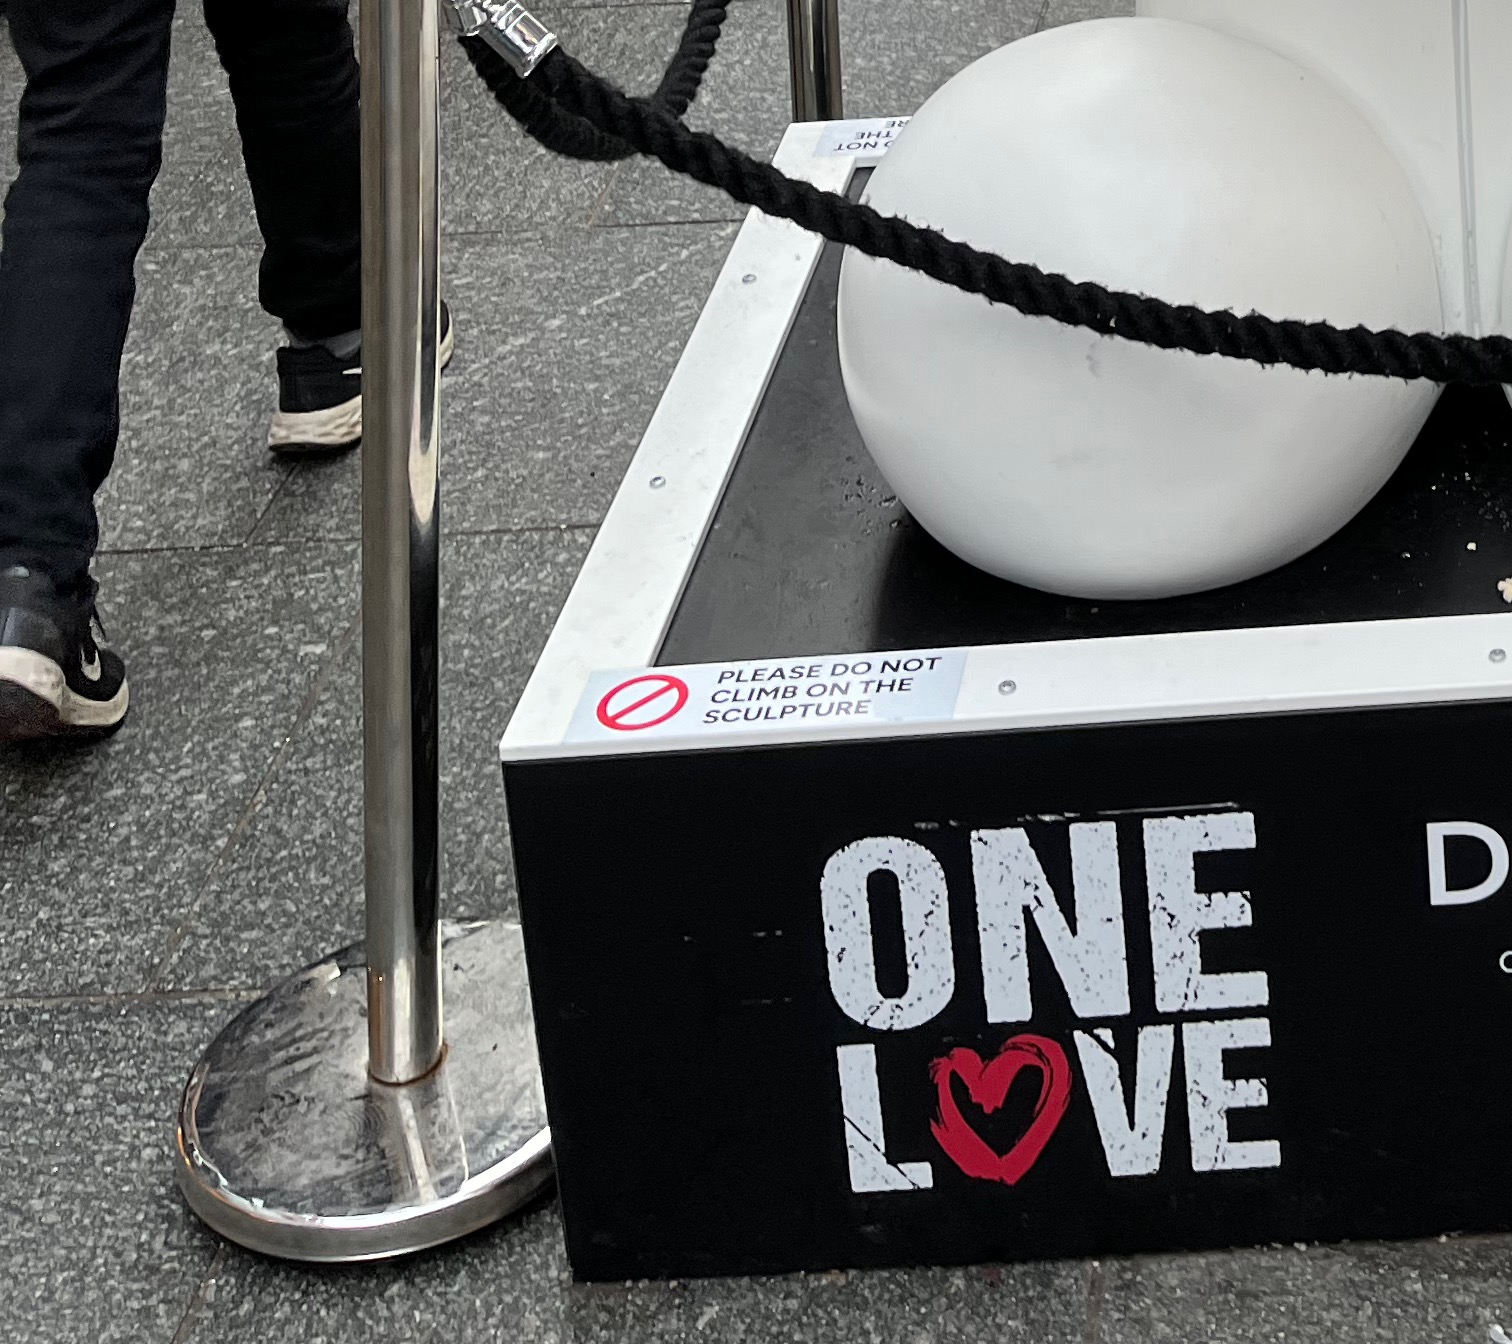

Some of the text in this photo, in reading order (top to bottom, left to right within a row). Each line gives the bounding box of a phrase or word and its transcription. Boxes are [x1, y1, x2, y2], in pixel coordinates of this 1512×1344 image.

[717, 657, 942, 684] PLEASE DO NOT
[711, 678, 913, 703] CLIMB ON THE
[703, 700, 871, 724] SCULPTURE
[821, 812, 1269, 1030] ONE
